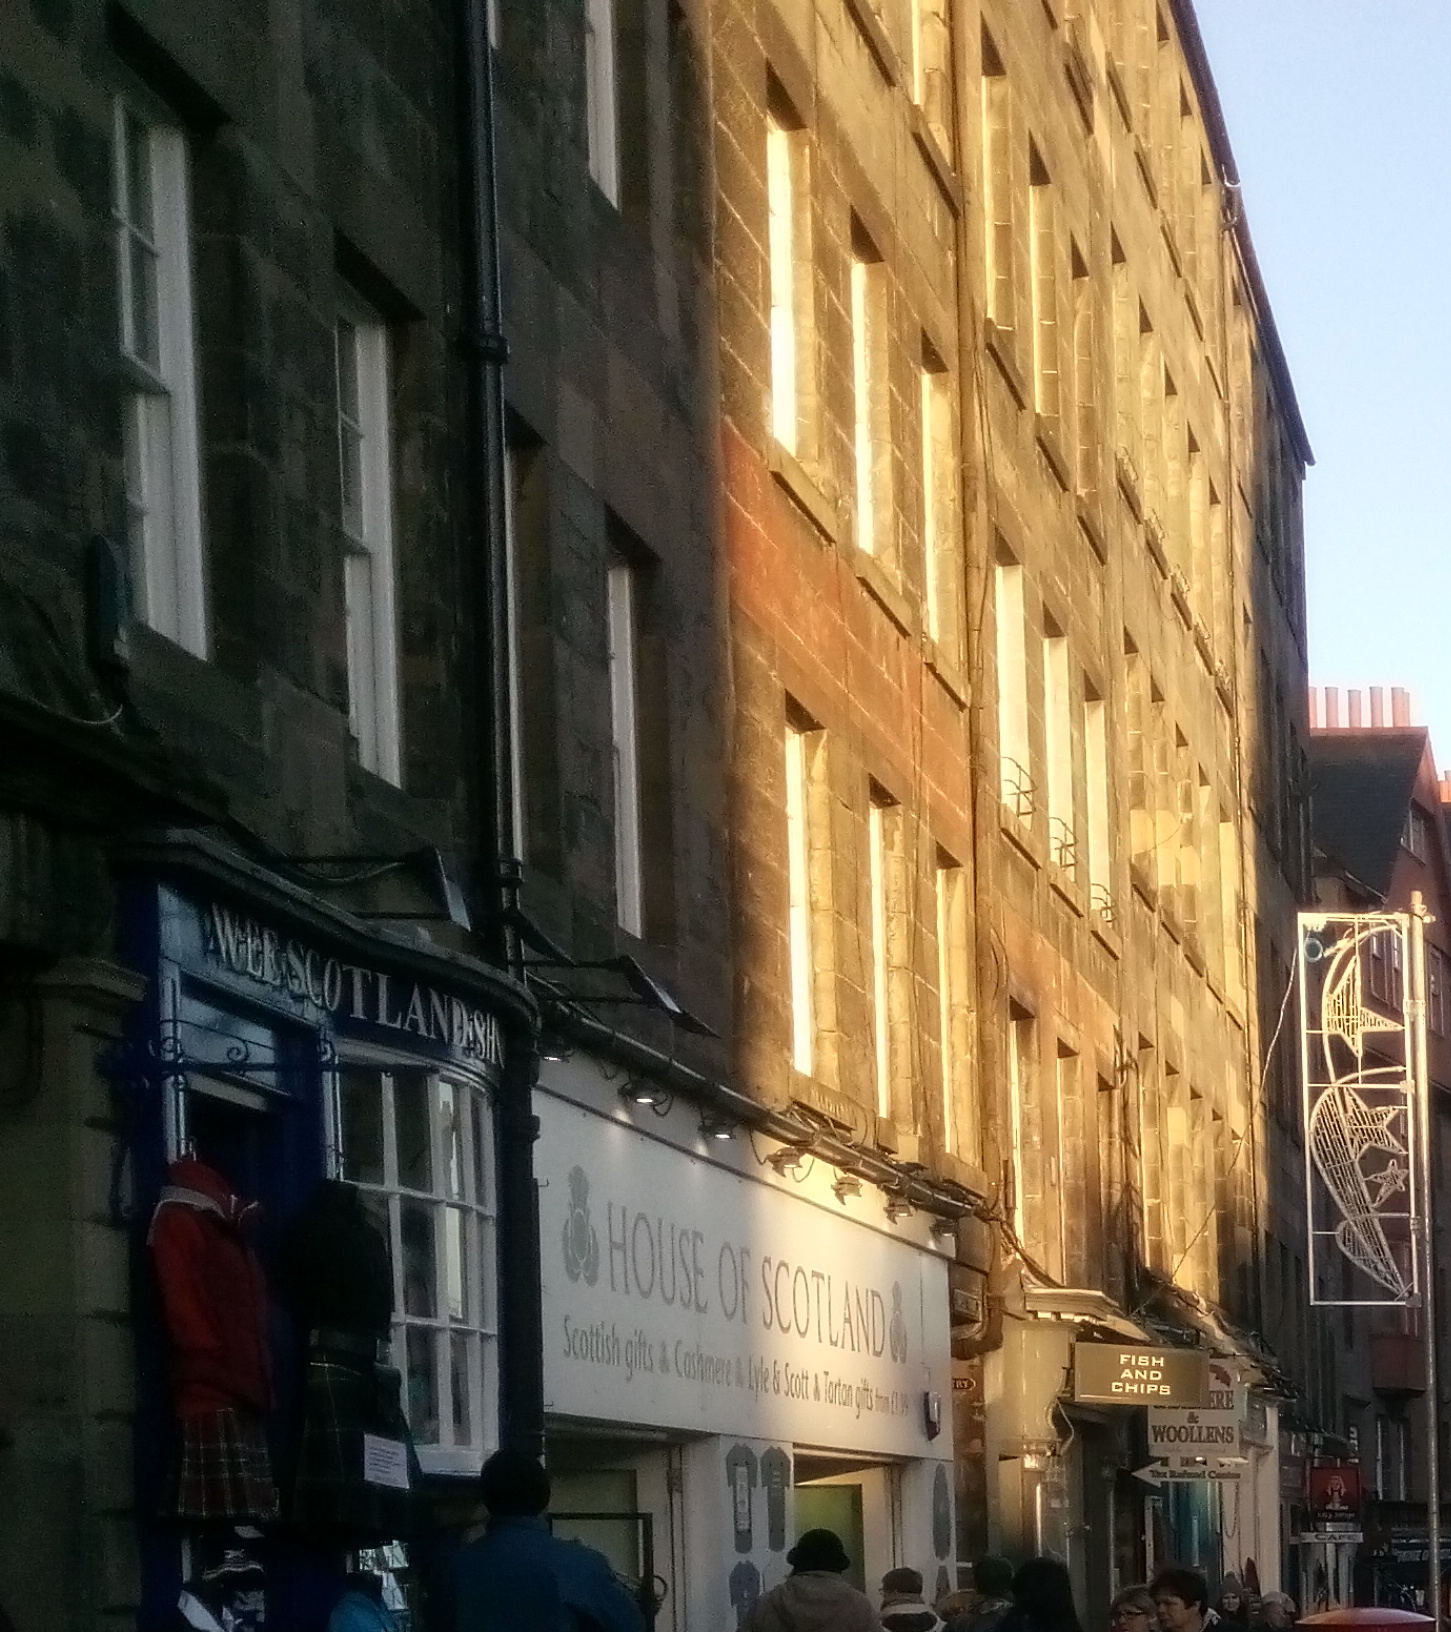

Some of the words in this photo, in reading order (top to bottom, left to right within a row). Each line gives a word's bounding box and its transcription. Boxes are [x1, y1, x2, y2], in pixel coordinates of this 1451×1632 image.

[286, 939, 468, 1046] SCOTLAND
[606, 1199, 709, 1315] HOUSE
[718, 1240, 751, 1326] OF
[761, 1255, 887, 1358] SCOTLAND
[563, 1314, 621, 1367] Scottish
[625, 1328, 653, 1383] gifts
[675, 1338, 731, 1387] Cashmere
[750, 1355, 769, 1403] Lyle
[784, 1362, 809, 1400] Scott
[824, 1370, 853, 1408] Tartan
[855, 1376, 874, 1420] gifts
[1120, 1354, 1165, 1367] FISH
[1120, 1369, 1162, 1381] AND
[1111, 1382, 1171, 1395] CHIPS
[1187, 1411, 1199, 1424] &
[1152, 1425, 1234, 1443] WOOLLENS
[1149, 1469, 1167, 1479] Tax
[1169, 1469, 1206, 1479] Refund
